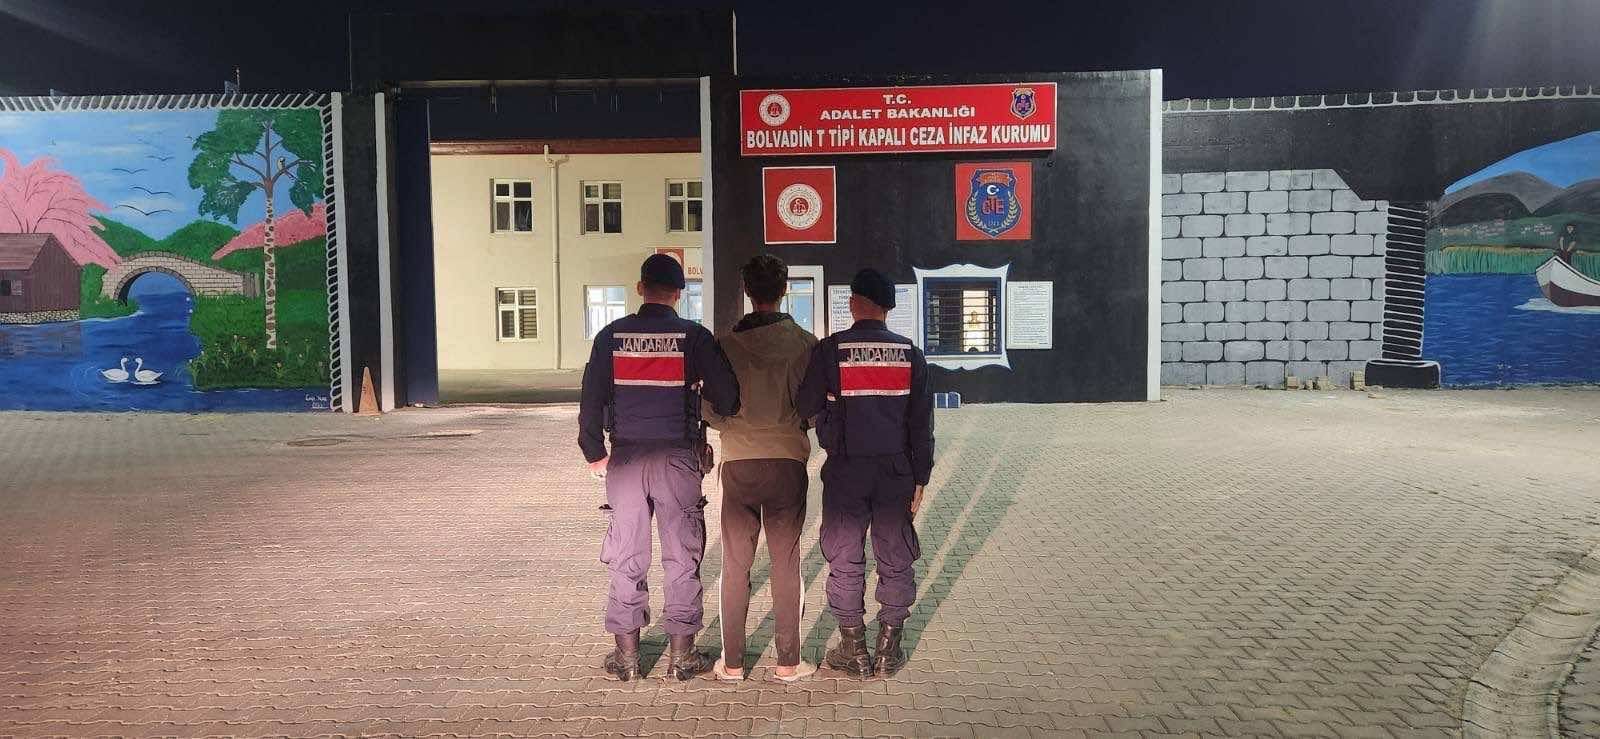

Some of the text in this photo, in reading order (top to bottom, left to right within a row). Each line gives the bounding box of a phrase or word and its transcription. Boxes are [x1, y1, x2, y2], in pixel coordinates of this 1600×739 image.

[883, 94, 912, 104] T.C.
[820, 105, 976, 120] ADALET BAKANLIĞI
[747, 122, 1051, 148] BOLVADİN T TİPİ KAPALI CEZA İNFAZ KURUMU
[619, 338, 679, 352] JANDARMA
[847, 348, 907, 362] JANDARMA
